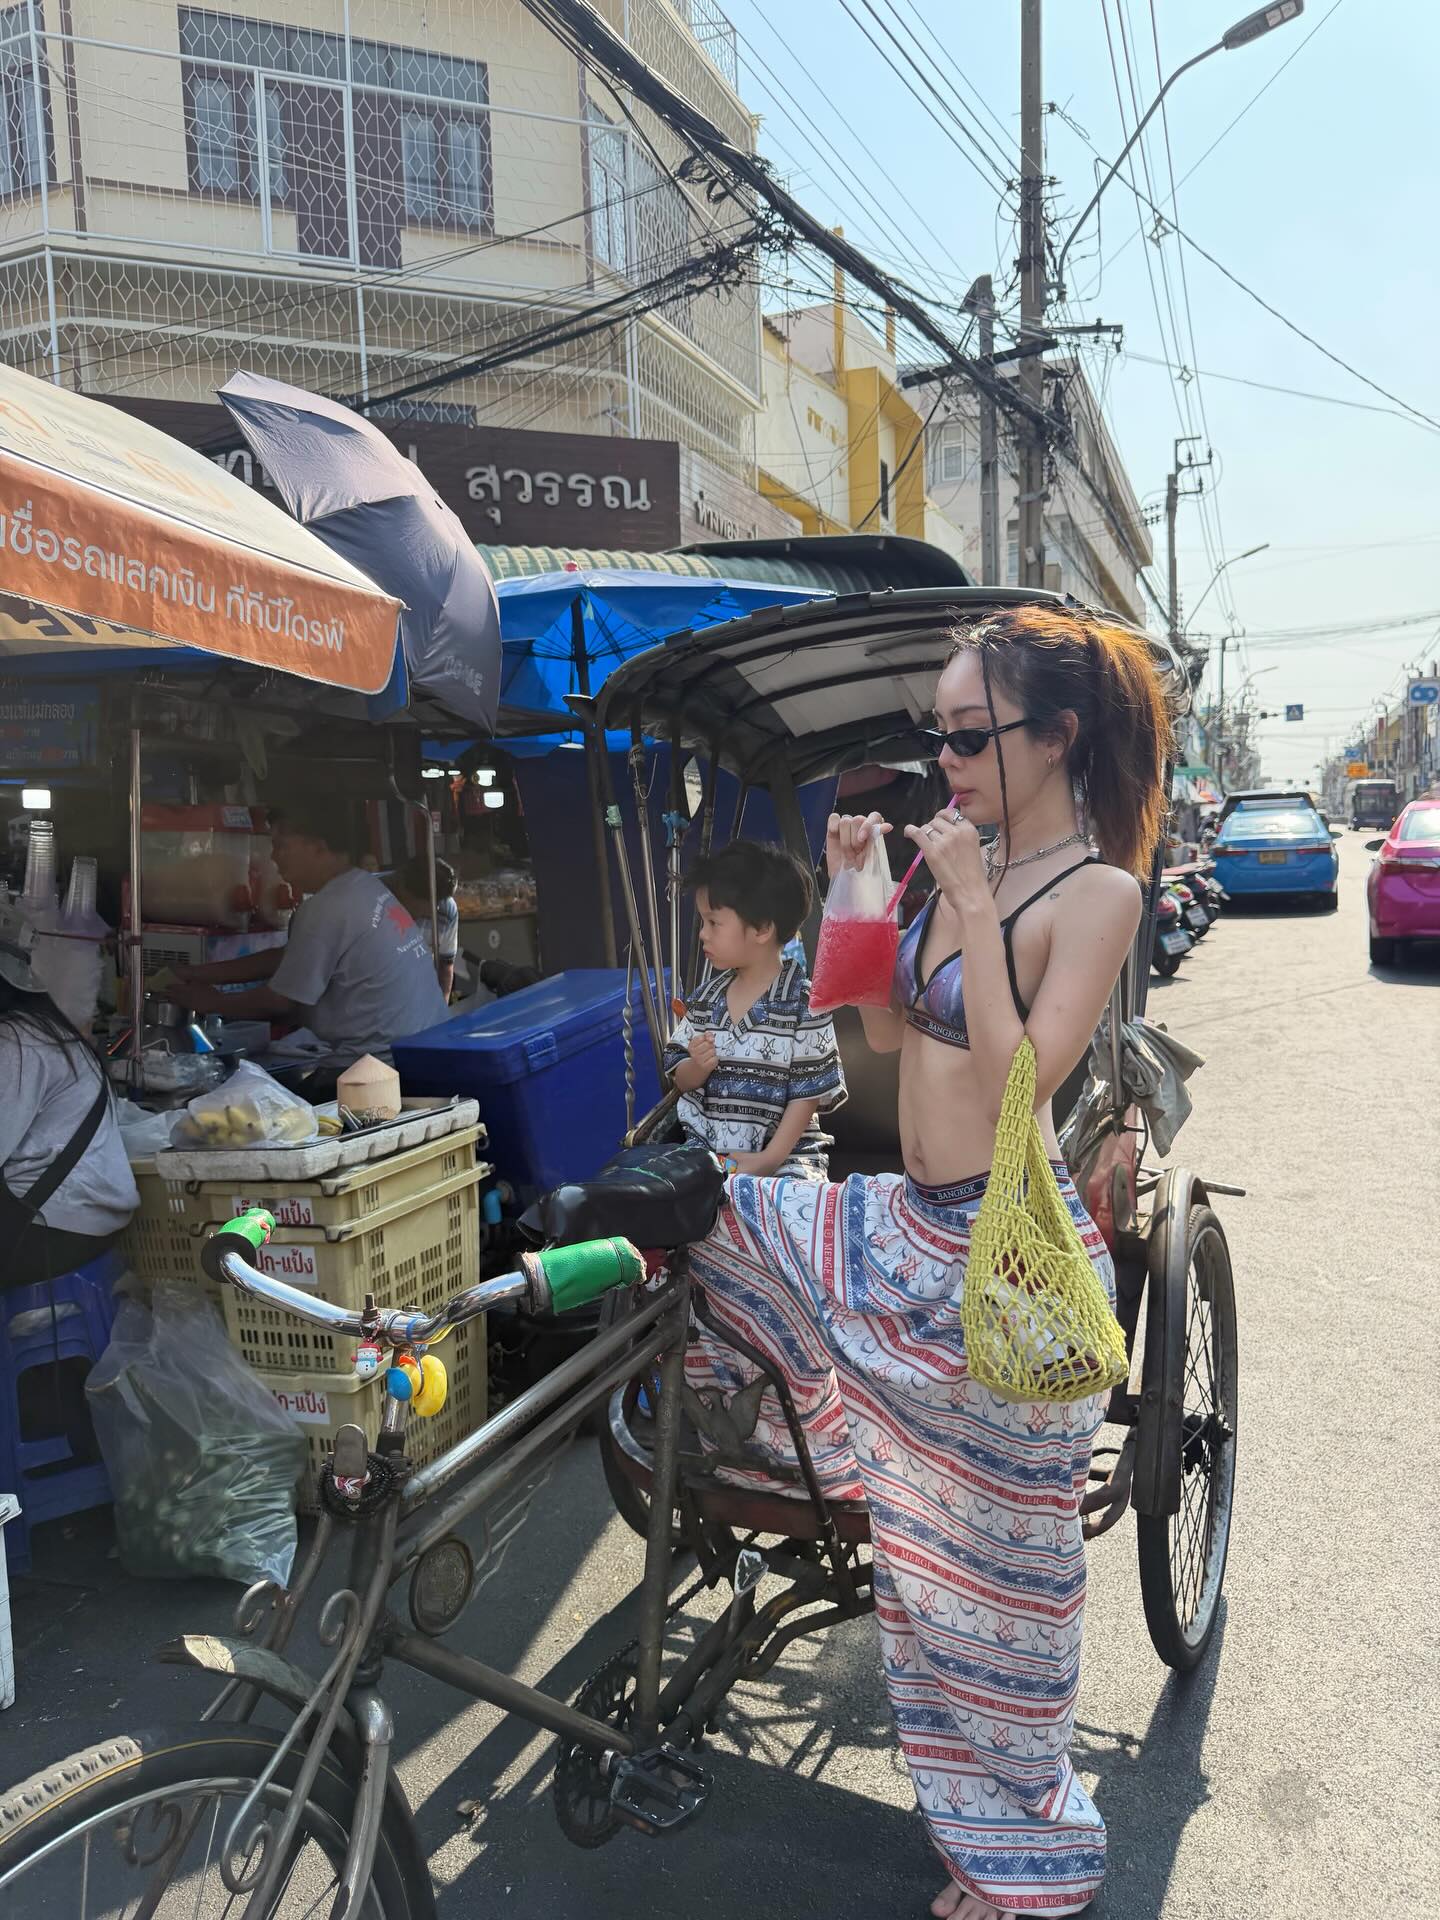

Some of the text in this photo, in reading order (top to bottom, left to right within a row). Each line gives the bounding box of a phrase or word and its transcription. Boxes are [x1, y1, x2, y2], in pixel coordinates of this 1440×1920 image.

[464, 463, 652, 525] สุวรรณ
[927, 1021, 968, 1042] BANGKOK
[738, 1105, 763, 1117] MERGE
[937, 1184, 976, 1200] BANGKOK
[823, 1194, 838, 1275] MERGE MERGE
[896, 1342, 929, 1361] MERGE
[812, 1411, 838, 1431] MERGE
[839, 1382, 866, 1406] MERGE
[966, 1472, 999, 1494] MERGE
[1016, 1494, 1053, 1505] MERGE
[900, 1549, 1036, 1611] MERGE MERGE MERGE
[942, 1683, 1029, 1717] MERGE MERGE
[929, 1747, 954, 1761] MERGE
[946, 1860, 973, 1890] MERGE
[987, 1894, 1020, 1909] MERGE
[1036, 1895, 1066, 1909] MERGE
